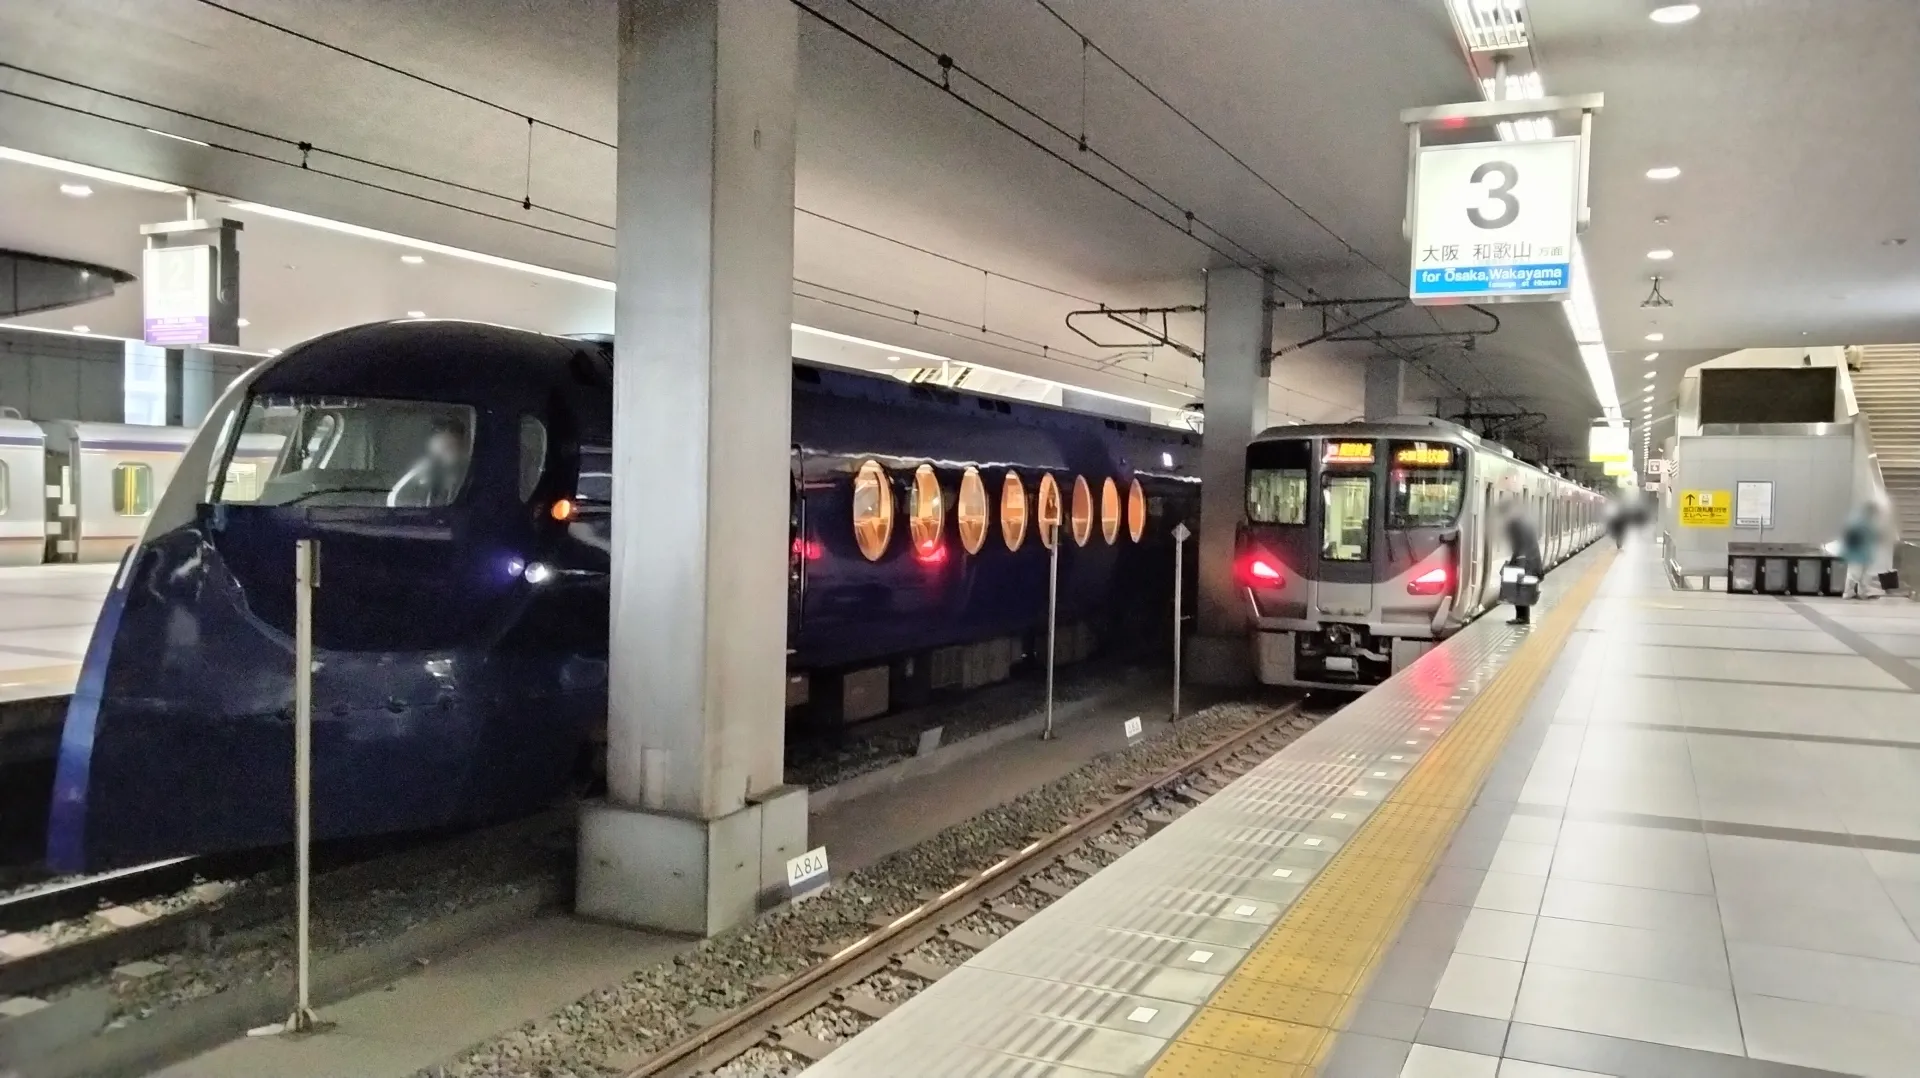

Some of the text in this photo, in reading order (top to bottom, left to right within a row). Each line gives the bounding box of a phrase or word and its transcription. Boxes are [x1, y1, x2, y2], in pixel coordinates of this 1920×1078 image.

[1466, 160, 1520, 230] 3
[1422, 241, 1564, 262] 大阪 和歌山 方面
[1422, 270, 1441, 283] for
